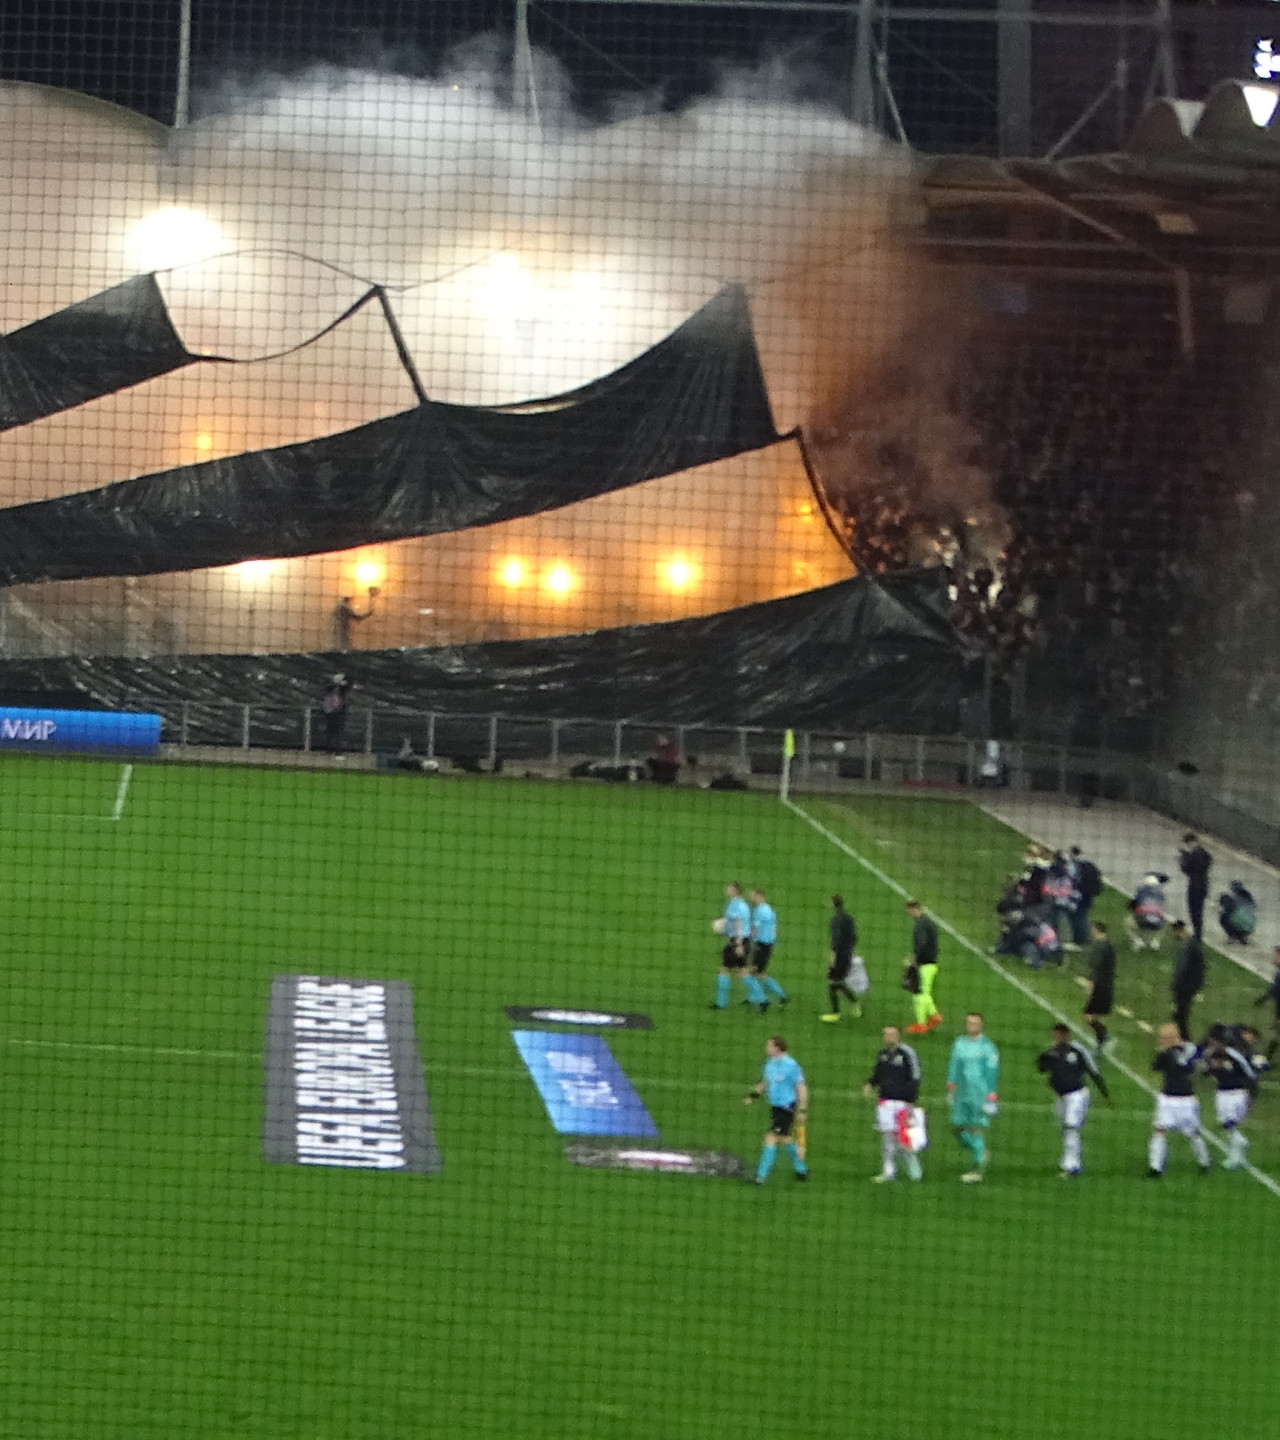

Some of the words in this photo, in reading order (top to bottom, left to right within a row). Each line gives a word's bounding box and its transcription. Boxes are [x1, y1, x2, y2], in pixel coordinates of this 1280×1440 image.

[1, 717, 57, 741] МИР
[293, 1042, 399, 1112] EUROPA
[295, 1111, 406, 1169] UEFA
